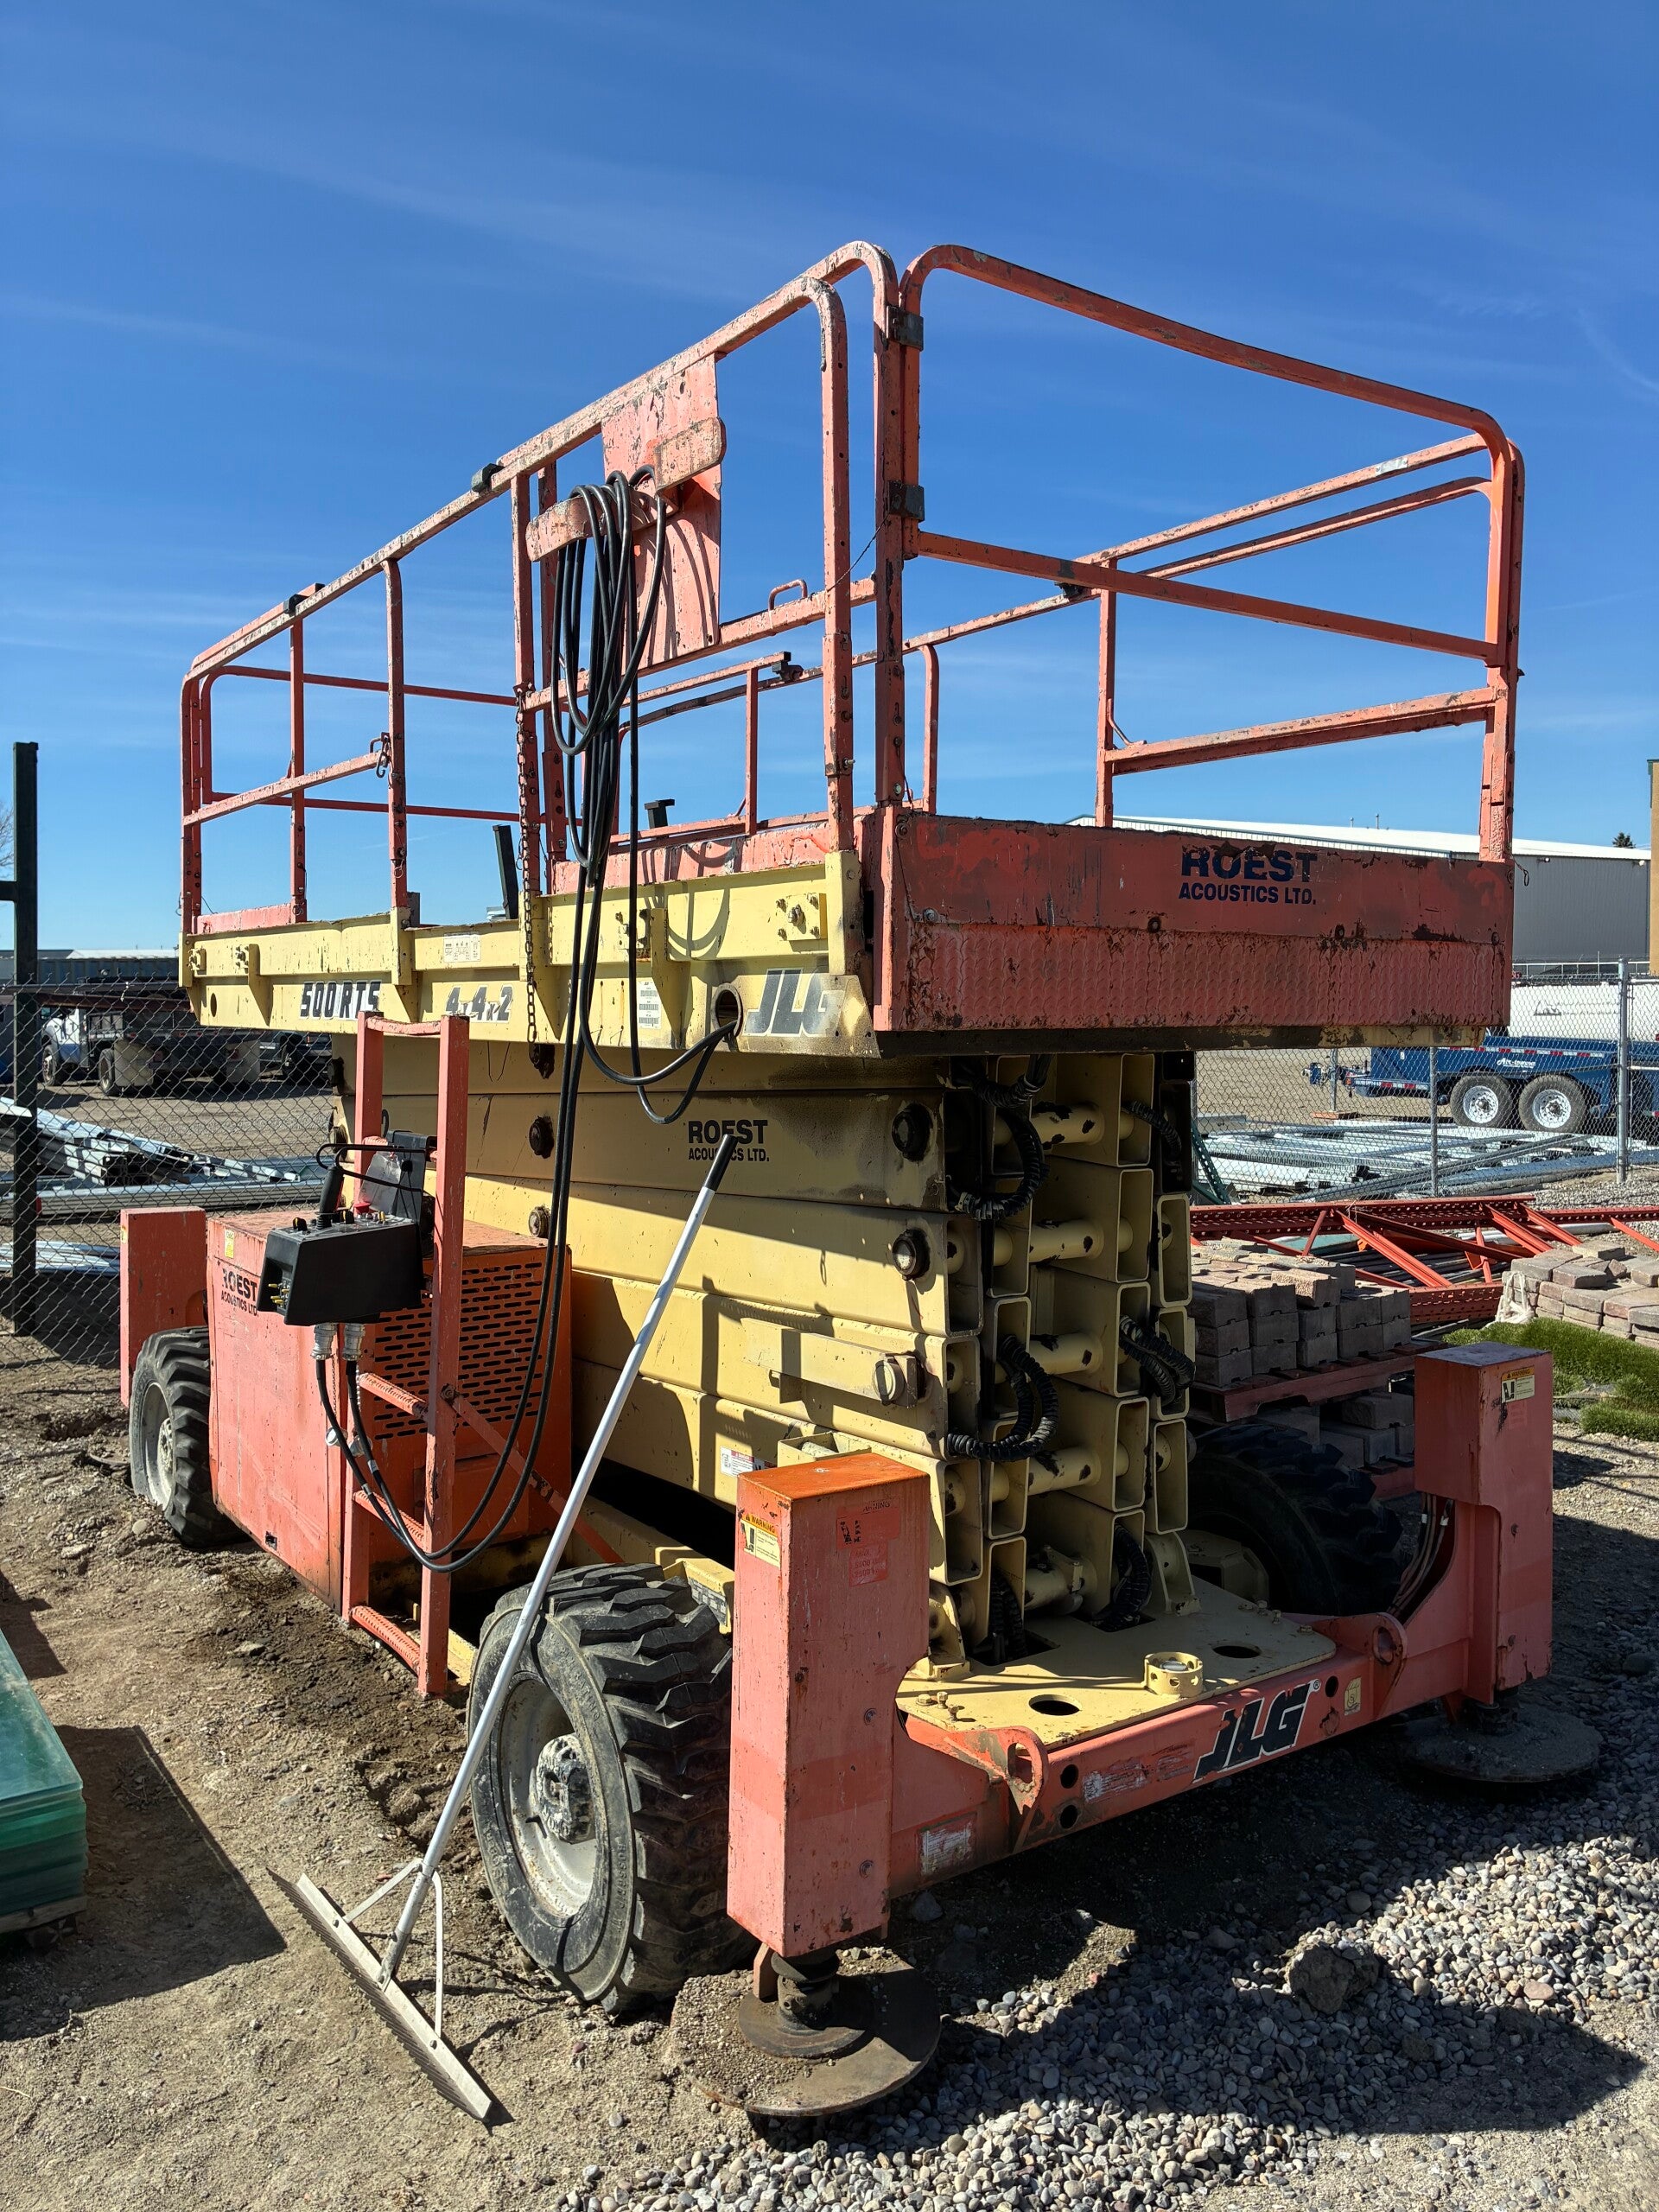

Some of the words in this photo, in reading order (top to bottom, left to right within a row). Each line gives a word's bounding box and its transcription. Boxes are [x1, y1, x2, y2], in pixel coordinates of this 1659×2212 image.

[1181, 844, 1318, 882] ROEST
[1179, 882, 1279, 904] ACOUSTICS
[1285, 887, 1316, 905] LTD.
[689, 1120, 768, 1144] ROEST
[689, 1147, 745, 1161] ACOUCS
[747, 1148, 770, 1161] LTD.
[752, 1515, 775, 1534] WARNING
